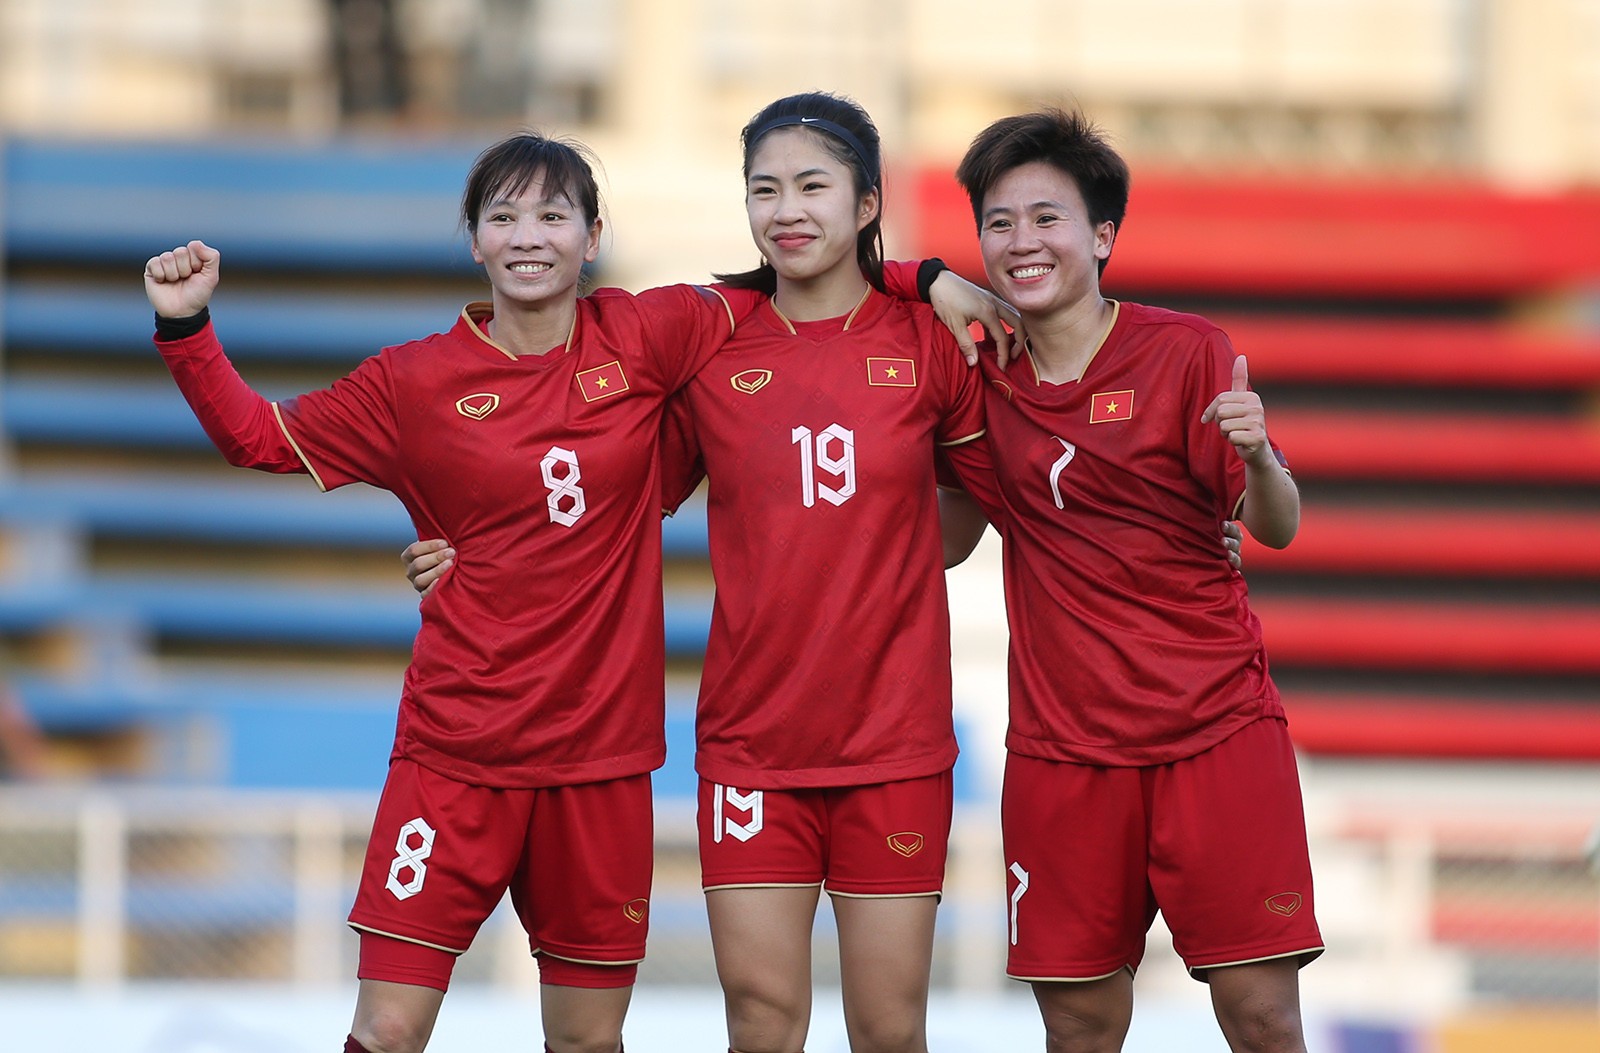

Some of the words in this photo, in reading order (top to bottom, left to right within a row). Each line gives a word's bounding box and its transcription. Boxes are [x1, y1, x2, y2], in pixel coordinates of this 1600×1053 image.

[540, 446, 586, 527] 8
[792, 423, 857, 508] 19
[1049, 436, 1076, 510] 7
[713, 783, 764, 844] 19
[385, 817, 437, 900] 8
[1008, 861, 1030, 946] 7
